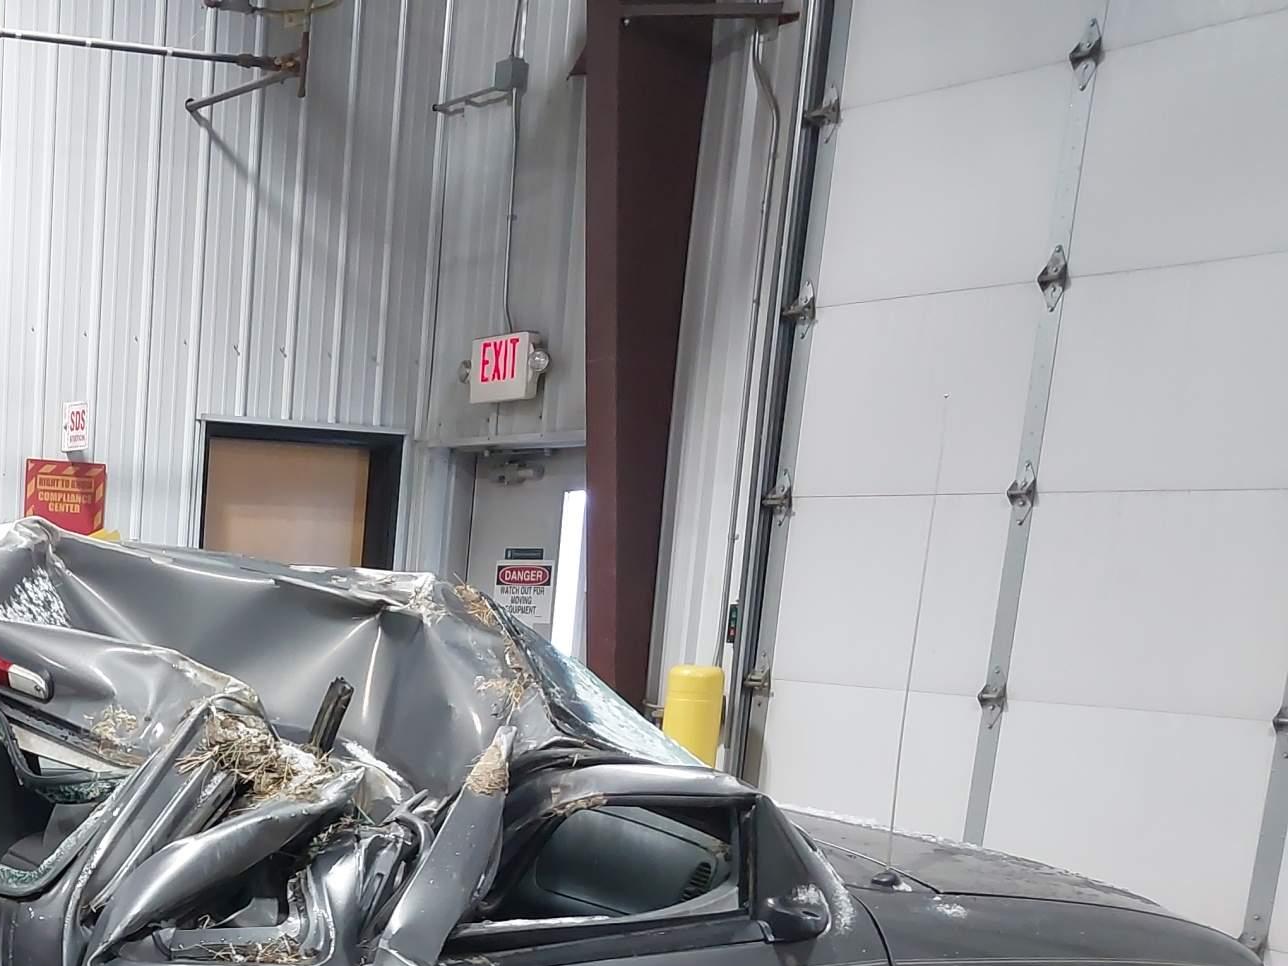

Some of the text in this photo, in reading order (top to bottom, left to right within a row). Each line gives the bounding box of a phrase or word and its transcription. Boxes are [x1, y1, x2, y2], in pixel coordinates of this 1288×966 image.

[480, 337, 520, 383] EXIT
[69, 409, 86, 431] SDS
[60, 479, 70, 489] TO
[38, 491, 92, 504] COMPLIANCE
[48, 502, 80, 513] CENTER
[504, 570, 543, 582] DANGER
[500, 586, 545, 596] WATCH OUT FOR
[510, 596, 532, 605] MOVING
